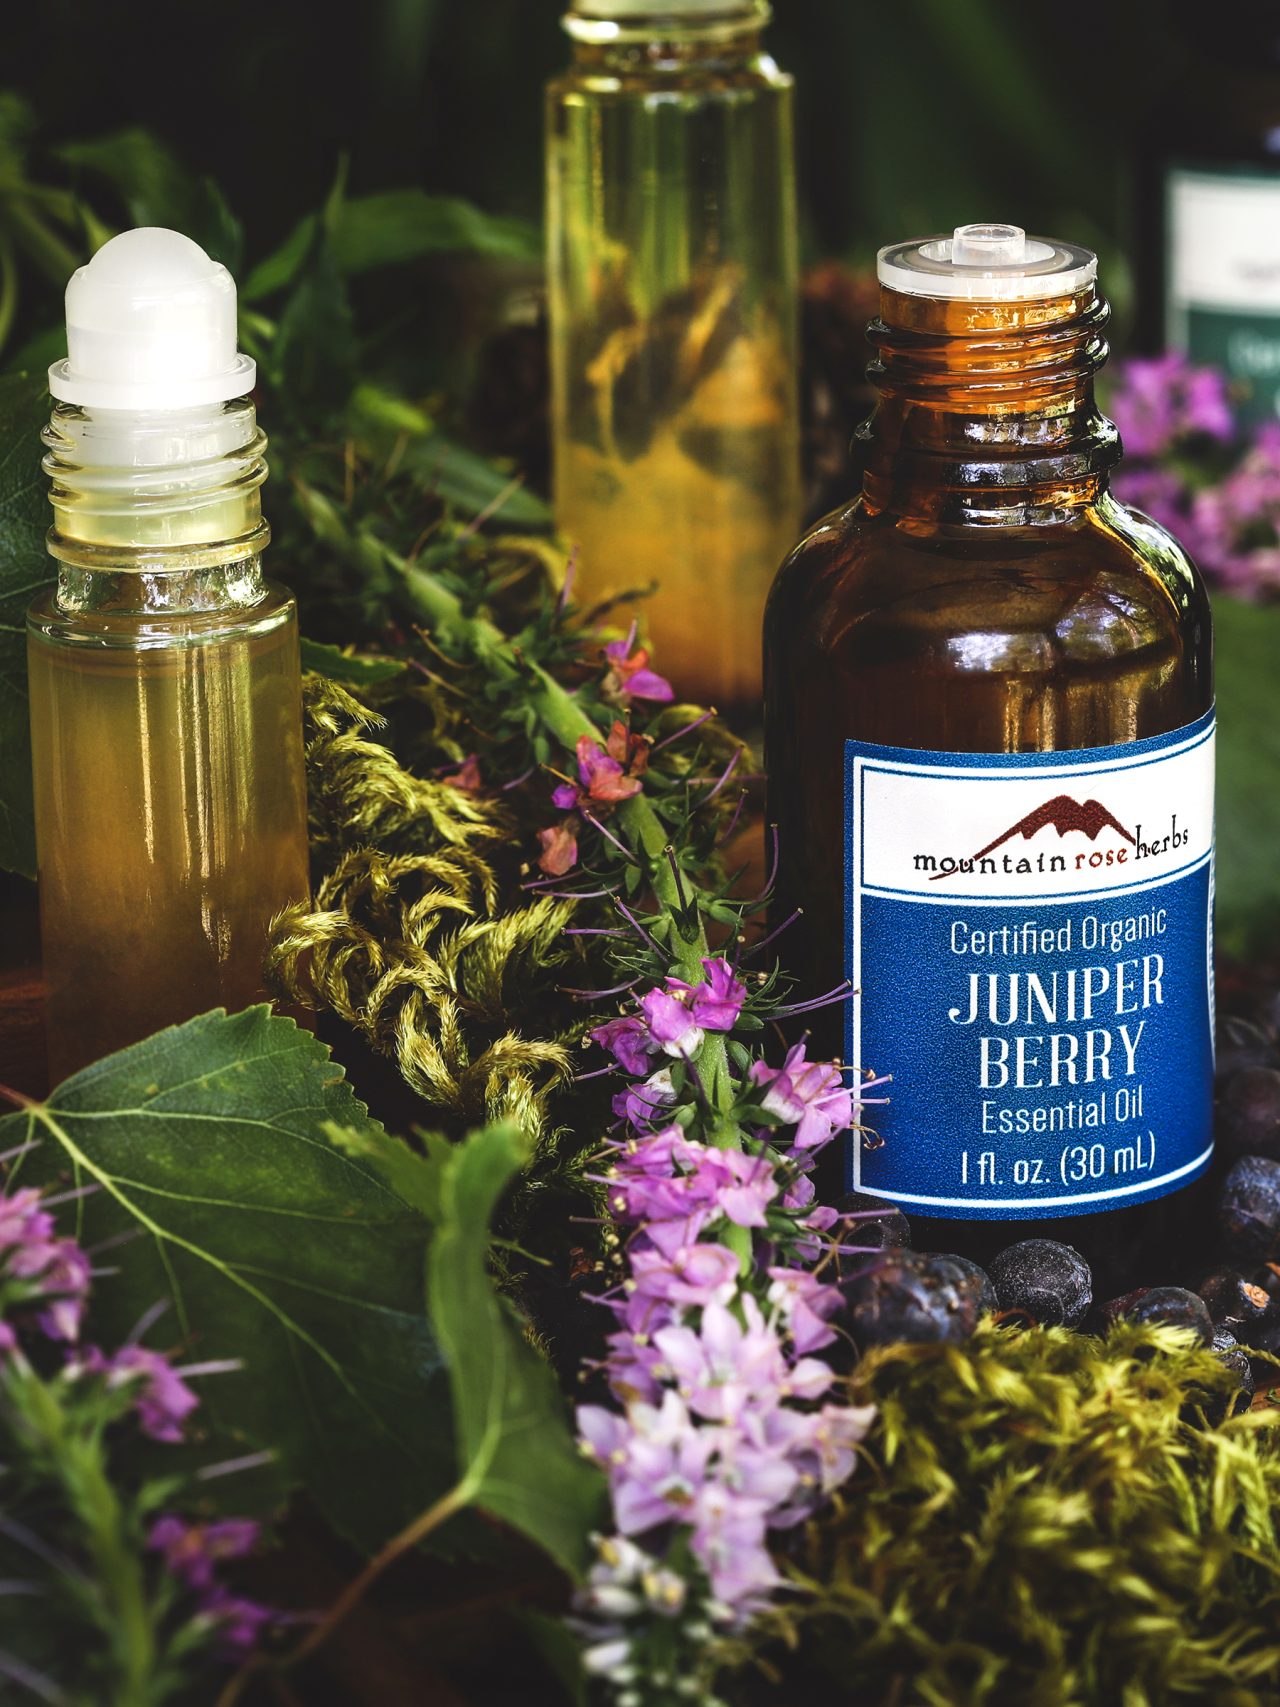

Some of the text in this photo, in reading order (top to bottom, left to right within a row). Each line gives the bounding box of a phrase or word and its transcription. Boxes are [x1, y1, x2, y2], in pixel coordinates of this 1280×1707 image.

[913, 814, 1190, 876] mountain rose herbs
[950, 907, 1168, 956] Certified Organic
[948, 953, 1165, 1026] JUNIPER
[978, 1021, 1147, 1090] BERRY
[981, 1085, 1144, 1134] Essential Oil
[977, 1151, 1004, 1186] fl.
[1013, 1159, 1051, 1185] oz.
[1060, 1143, 1105, 1187] (30
[1113, 1130, 1156, 1175] mL)
